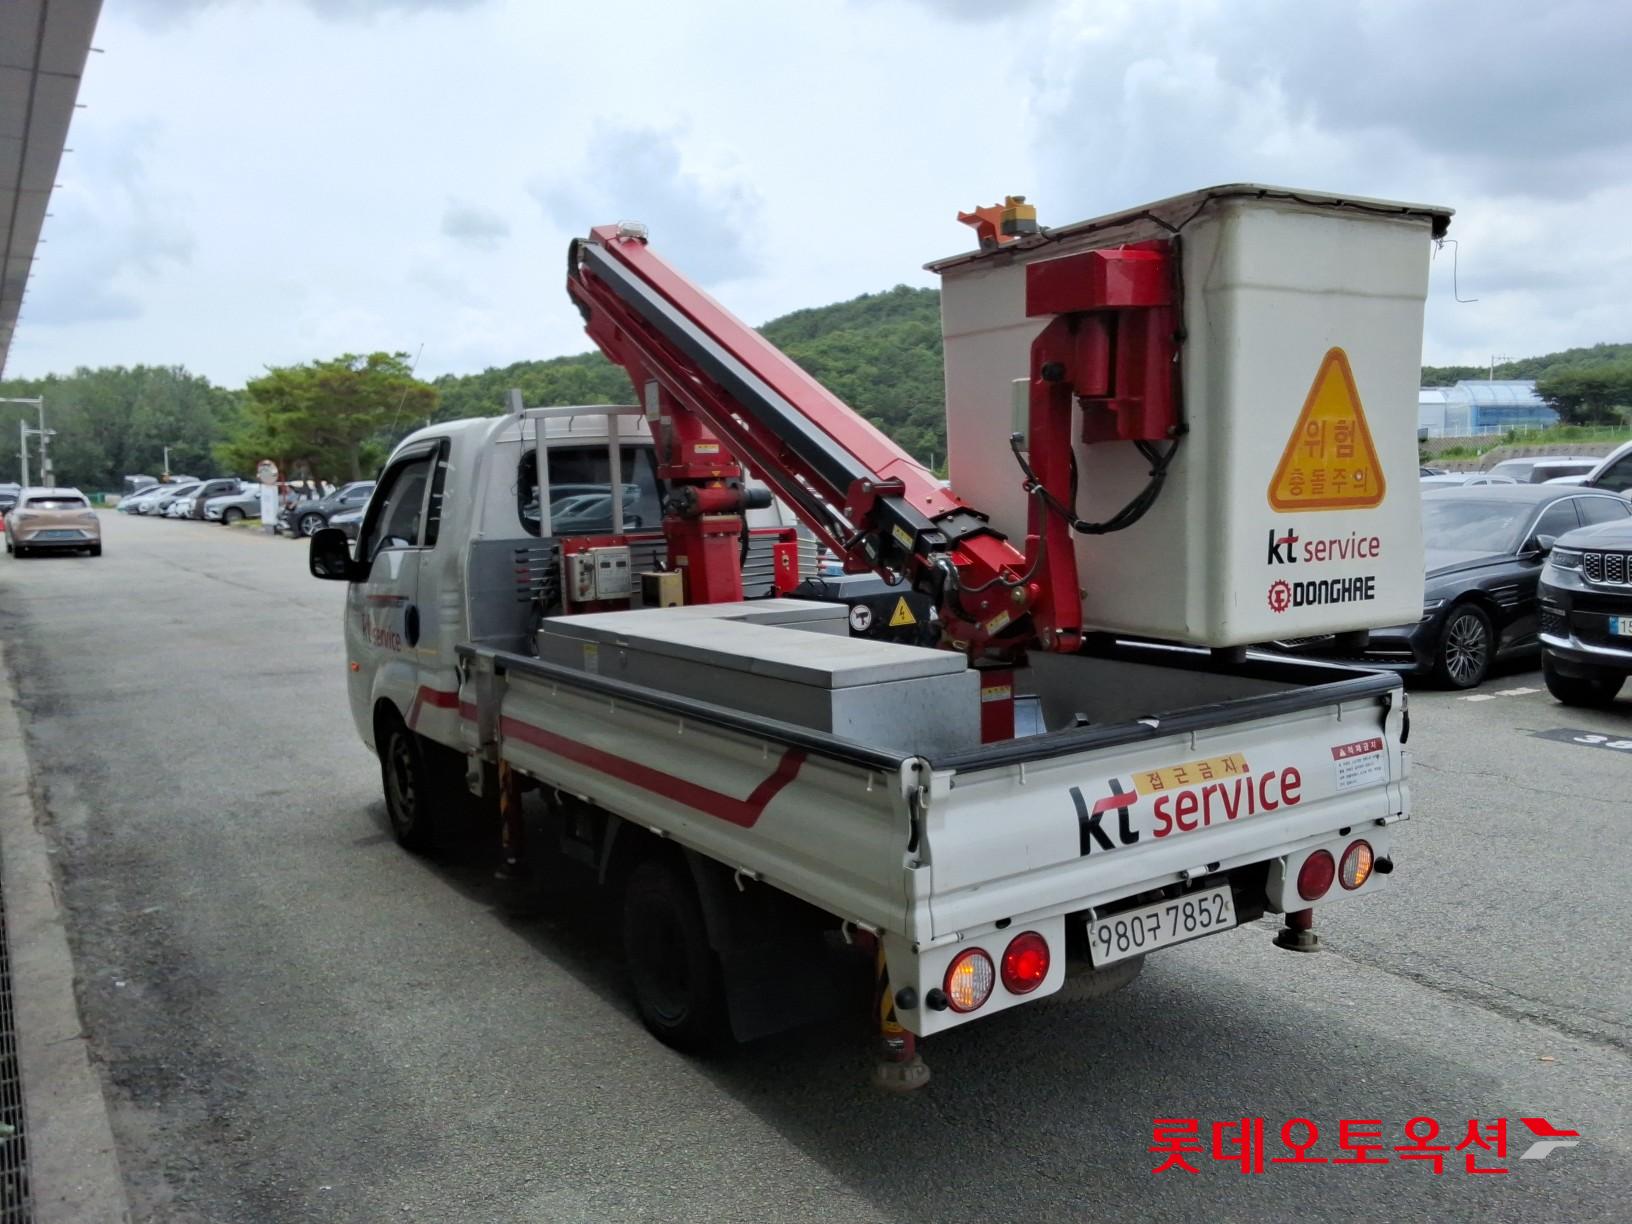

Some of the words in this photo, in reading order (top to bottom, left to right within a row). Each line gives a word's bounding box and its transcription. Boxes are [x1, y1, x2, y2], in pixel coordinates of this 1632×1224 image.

[1303, 419, 1356, 459] 위험
[1288, 467, 1368, 496] 충돌주의
[1267, 528, 1299, 565] kt
[1303, 531, 1380, 563] service
[1292, 576, 1375, 607] DONGHAE
[372, 626, 401, 652] service
[1147, 756, 1238, 791] 접근금지
[1069, 777, 1140, 857] kt
[1153, 763, 1302, 838] service
[1098, 912, 1161, 957] 980구
[1165, 893, 1228, 937] 7852
